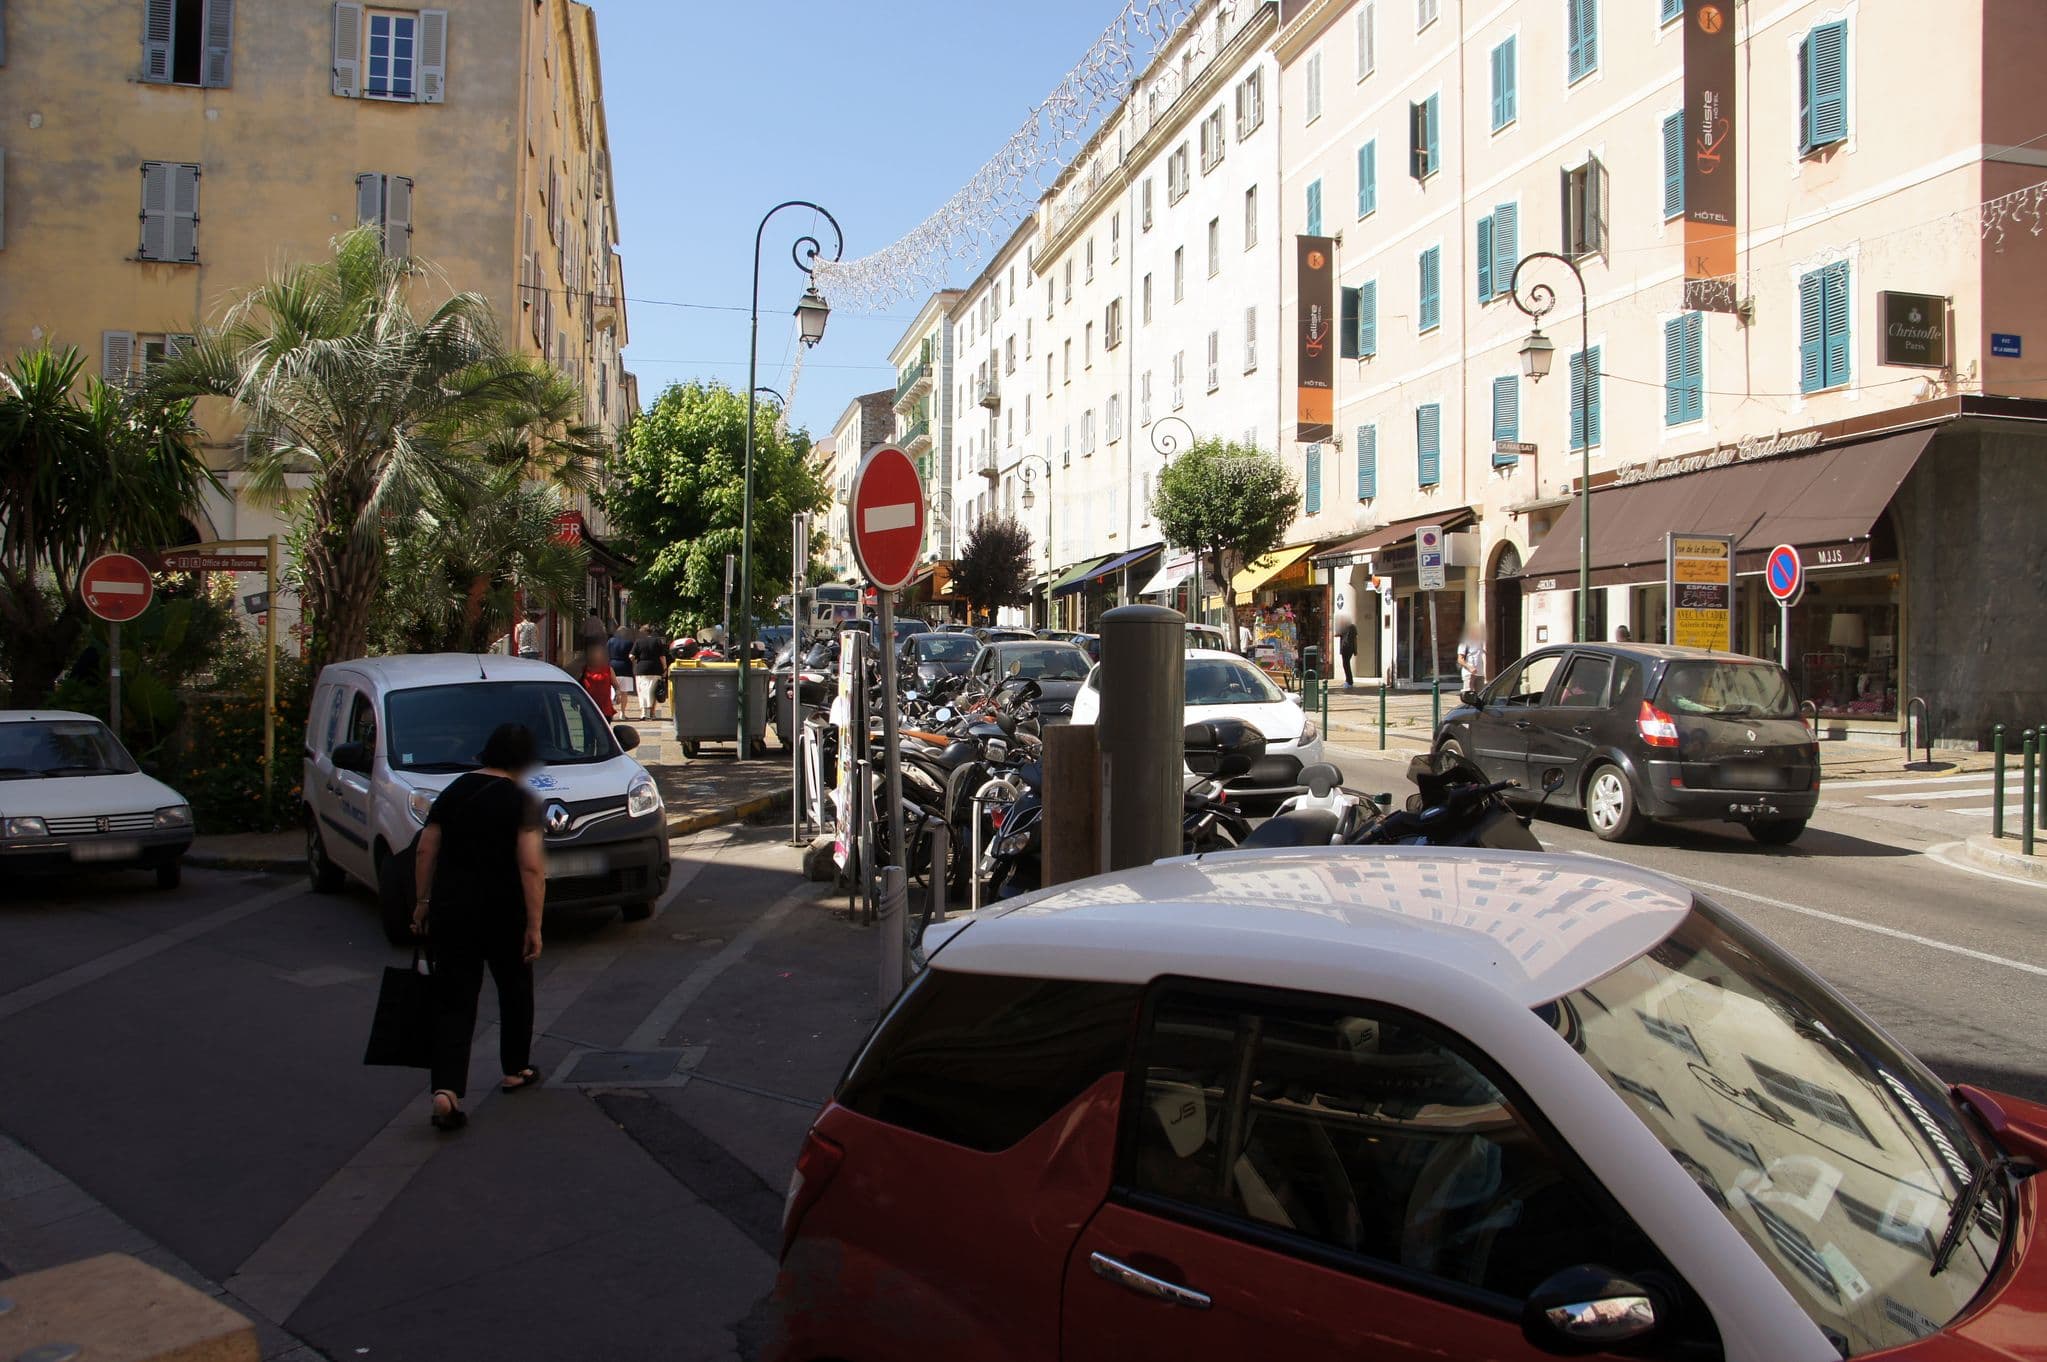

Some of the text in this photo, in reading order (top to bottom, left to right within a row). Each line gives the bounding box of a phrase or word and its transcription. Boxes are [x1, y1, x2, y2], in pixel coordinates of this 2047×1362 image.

[1694, 211, 1728, 222] HÔTEL
[1888, 322, 1942, 340] Christofle
[1905, 340, 1926, 351] Paris
[1640, 455, 1704, 482] Maison
[202, 559, 220, 567] Office
[231, 559, 257, 567] Tourisme
[1422, 555, 1431, 566] P
